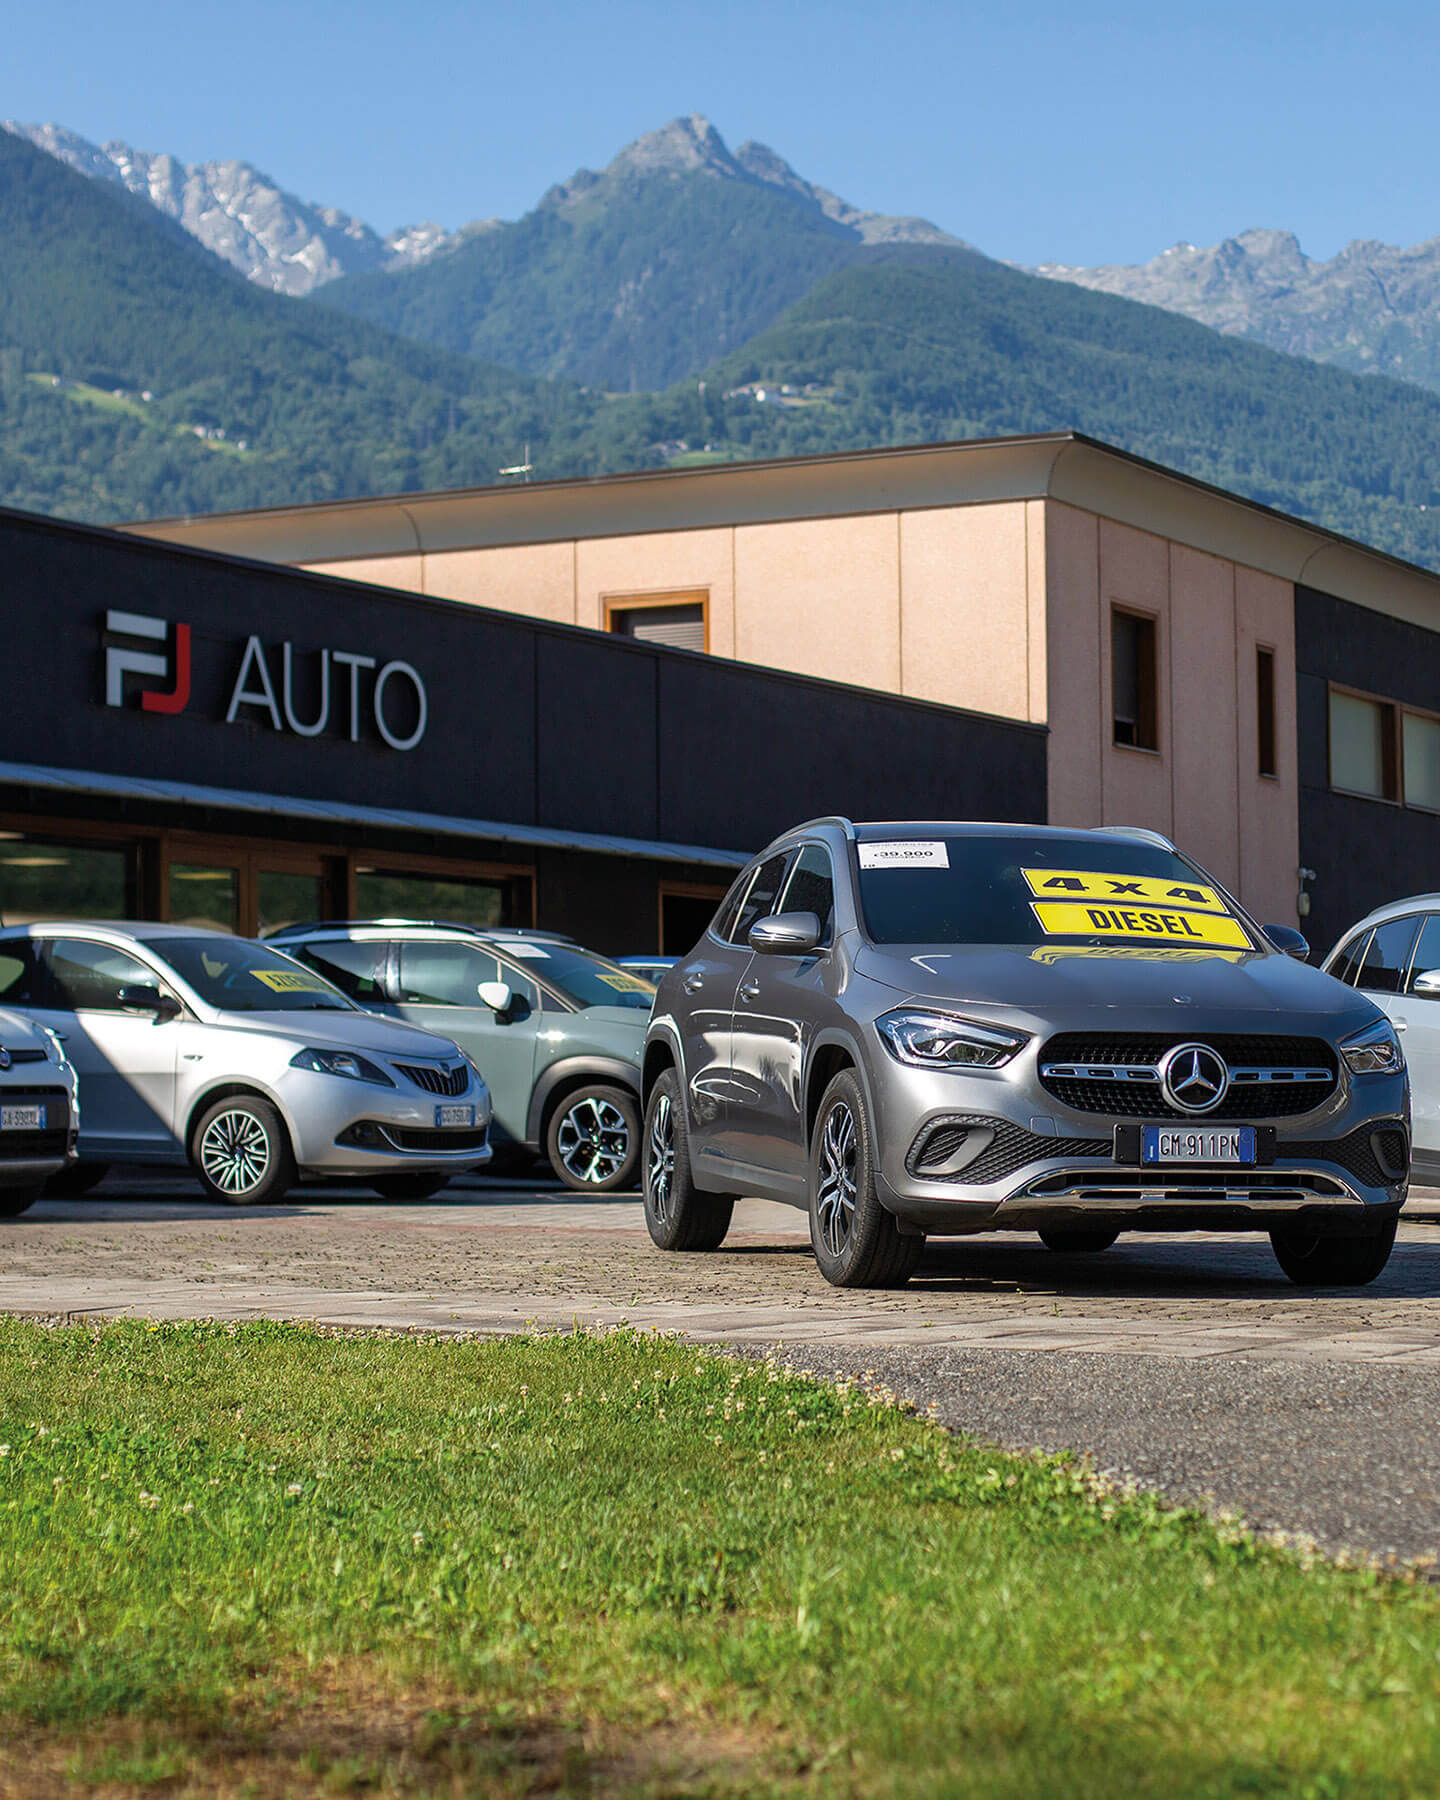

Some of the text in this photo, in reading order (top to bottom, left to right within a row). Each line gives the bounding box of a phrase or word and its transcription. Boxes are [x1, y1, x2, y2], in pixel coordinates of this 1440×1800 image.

[226, 635, 428, 750] AUTO
[1042, 877, 1090, 892] 4
[1166, 887, 1211, 904] 4
[1086, 909, 1203, 937] DIESEL
